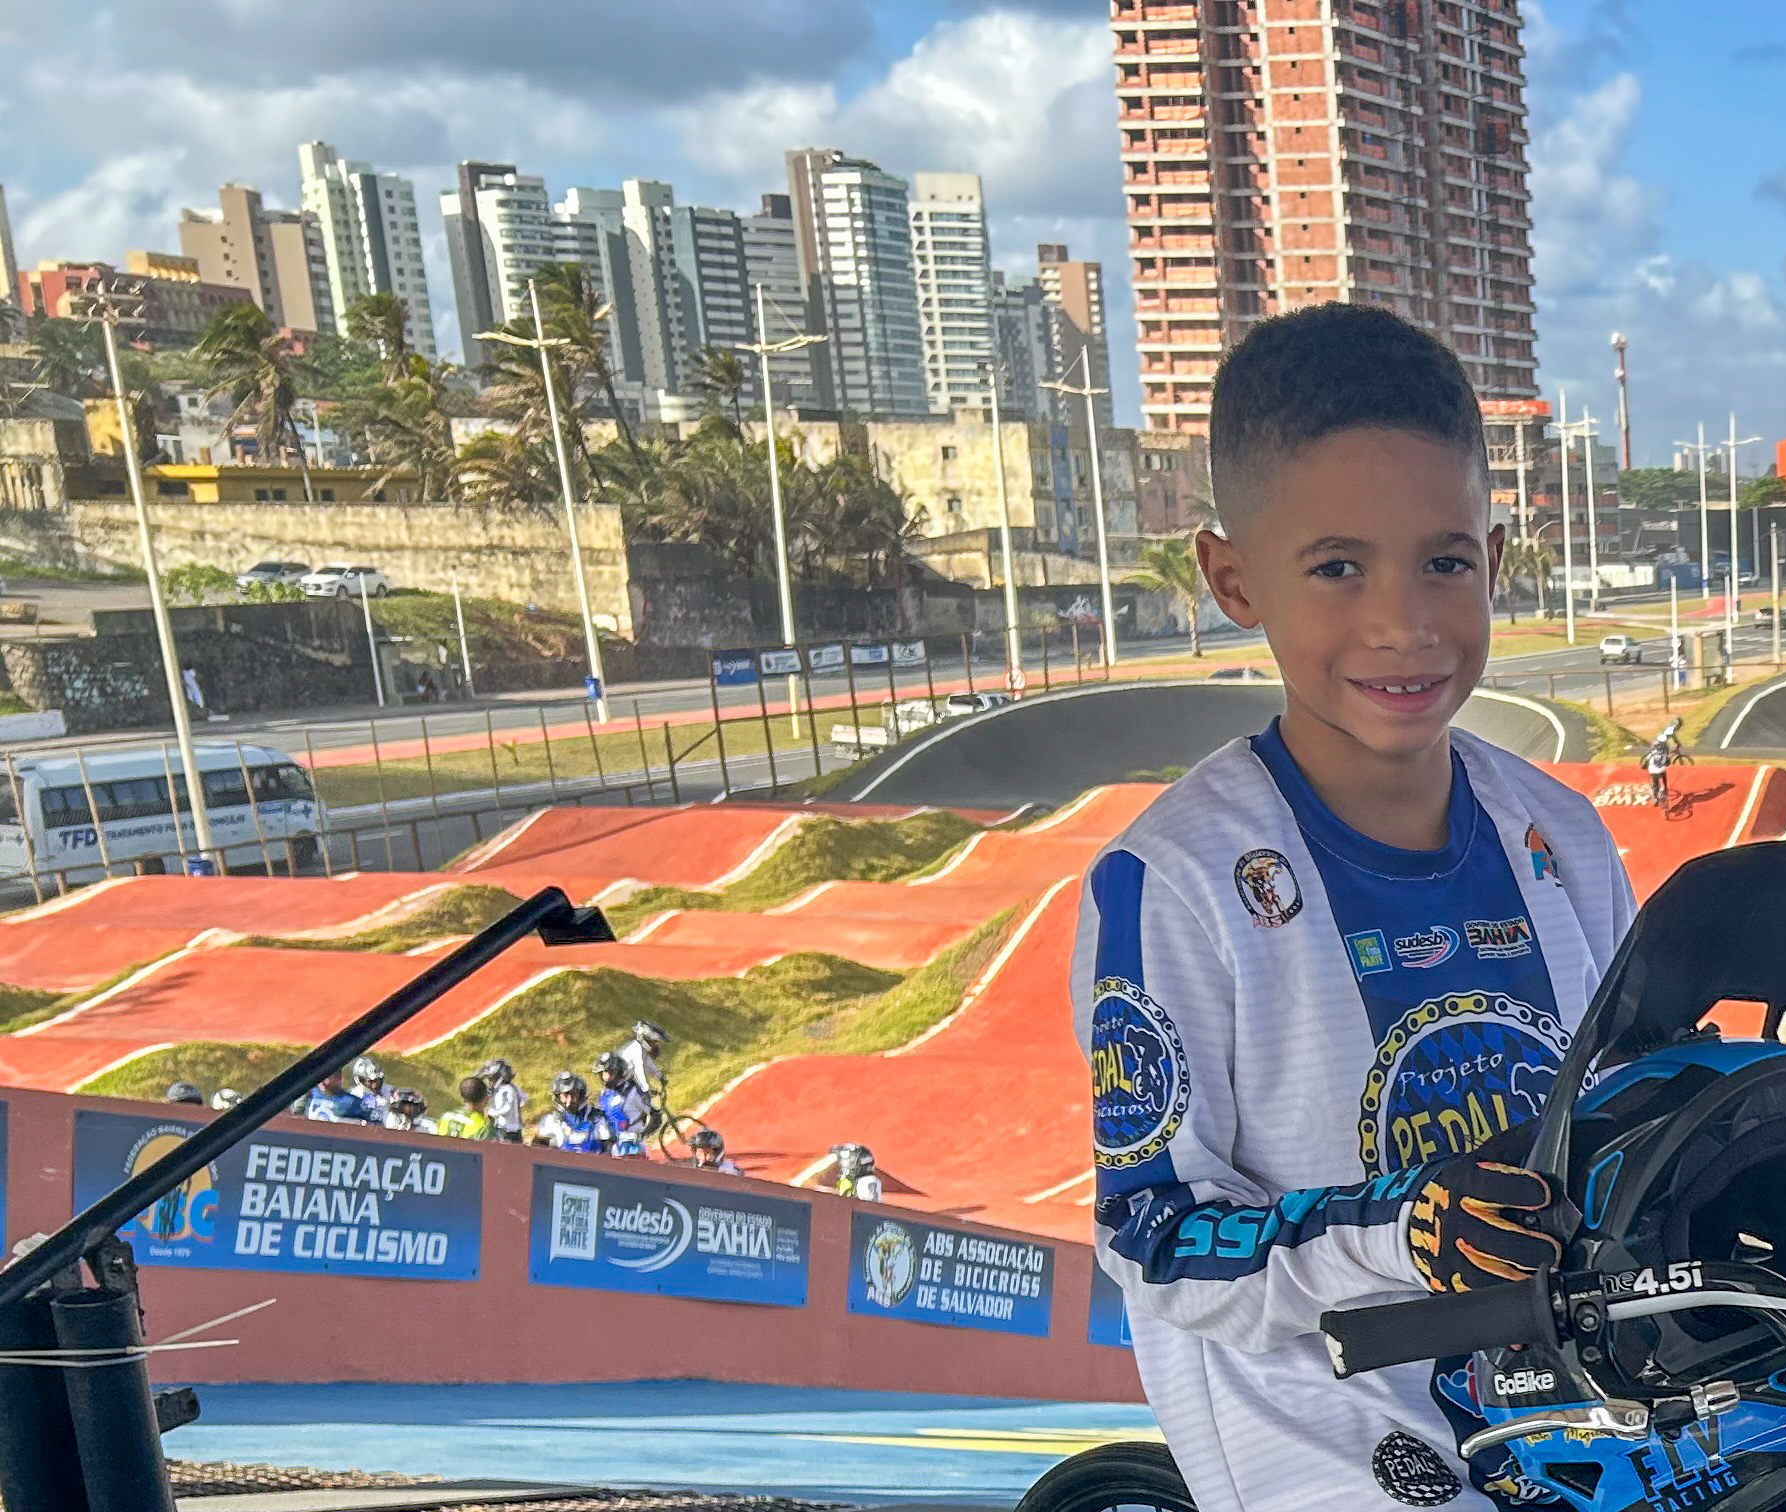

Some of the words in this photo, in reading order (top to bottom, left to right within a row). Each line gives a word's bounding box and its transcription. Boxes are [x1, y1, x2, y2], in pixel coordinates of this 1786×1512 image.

[59, 827, 98, 850] TFD
[1396, 932, 1443, 950] sudesb
[1398, 1053, 1504, 1097] Projeto
[246, 1143, 446, 1201] FEDERAÇÃO
[240, 1182, 380, 1227] BAIANA
[603, 1203, 674, 1235] sudesb
[234, 1220, 286, 1257] DE
[293, 1224, 448, 1266] CICLISMO
[923, 1231, 955, 1258] ABS
[957, 1237, 1044, 1273] ASSOCIAÇÃO
[920, 1257, 943, 1283] DE
[916, 1284, 937, 1310] DE
[940, 1288, 1014, 1320] SALVADOR
[1493, 1369, 1555, 1397] GoBike
[1384, 1453, 1436, 1480] PEDAL
